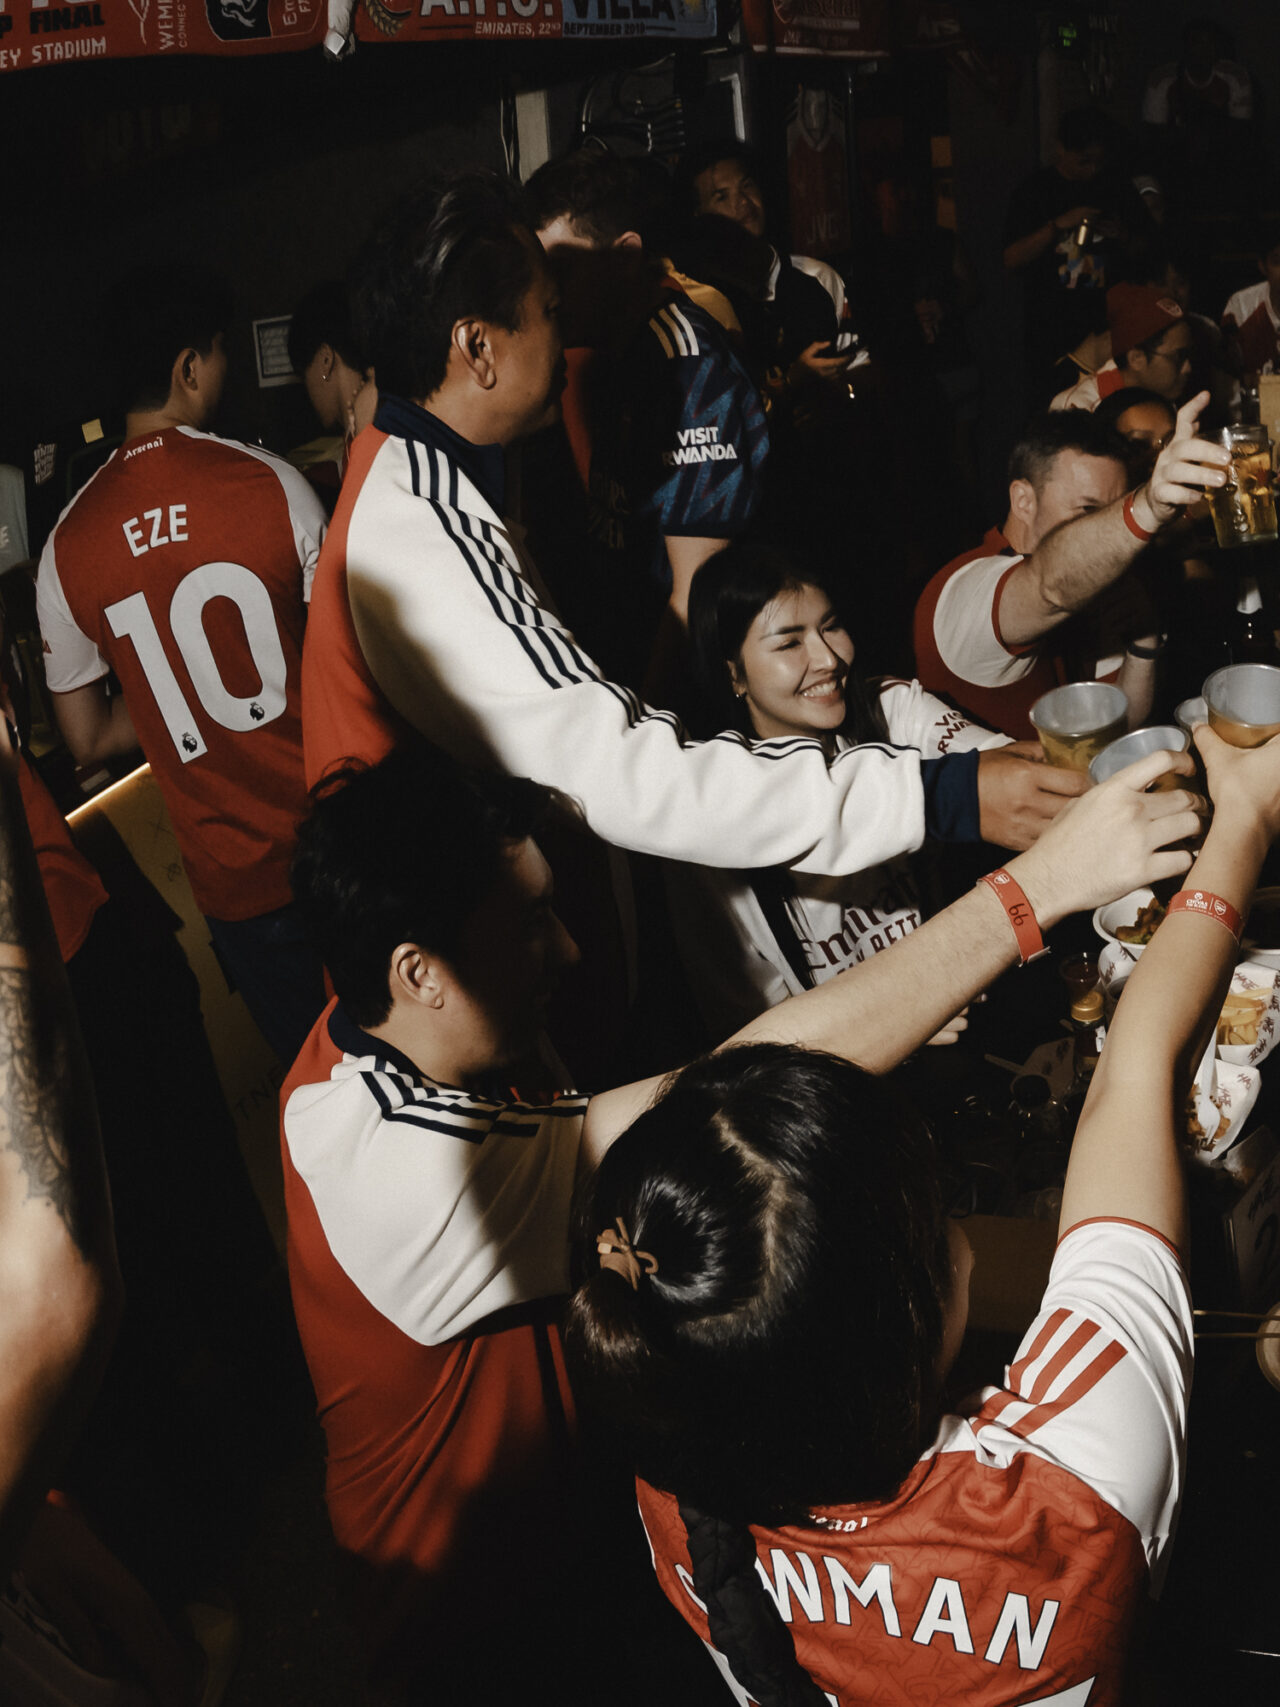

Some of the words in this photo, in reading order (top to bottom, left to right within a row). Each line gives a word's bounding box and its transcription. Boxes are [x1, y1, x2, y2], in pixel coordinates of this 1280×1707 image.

[30, 4, 104, 34] FINAL
[474, 21, 535, 37] EMIRATES,
[563, 22, 622, 35] SEPTEMBER
[32, 36, 107, 63] STADIUM
[123, 436, 163, 461] Arsenal
[677, 426, 719, 446] VISIT
[661, 443, 738, 467] RWANDA
[122, 503, 189, 558] EZE
[103, 561, 288, 764] 10
